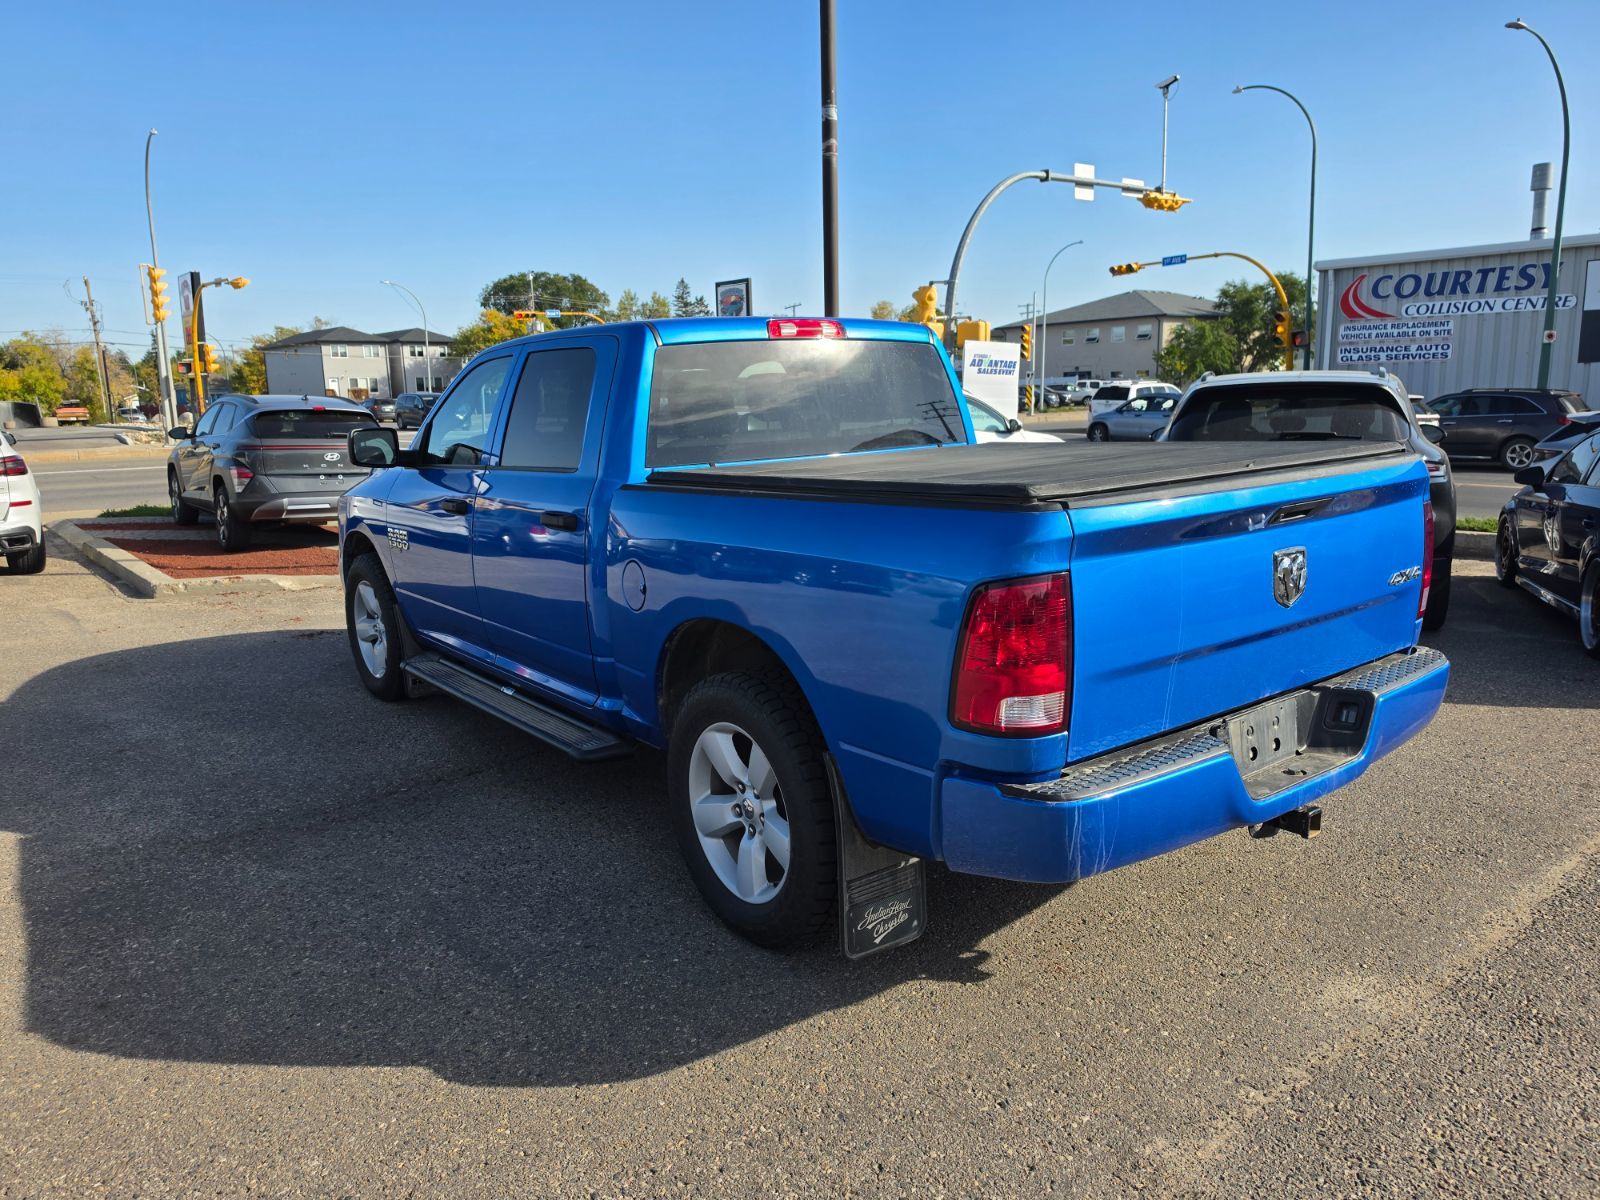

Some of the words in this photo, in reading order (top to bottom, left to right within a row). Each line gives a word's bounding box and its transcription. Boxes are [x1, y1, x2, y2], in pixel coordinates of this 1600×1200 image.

[1371, 262, 1564, 299] COURTESY
[1404, 299, 1496, 317] COLLISION
[1501, 295, 1571, 311] CENTRE
[1343, 323, 1389, 332] INSURANCE
[1390, 320, 1451, 330] REPLACEMENT
[1340, 332, 1373, 340] VEHICLE
[1375, 330, 1417, 339] AVAILABLE
[1434, 328, 1453, 337] SITE
[1340, 345, 1412, 355] INSURANCE
[1415, 343, 1451, 352] AUTO
[1340, 354, 1381, 363] GLASS
[1385, 351, 1449, 361] SERVICES
[969, 359, 1017, 369] ADVANTAGE
